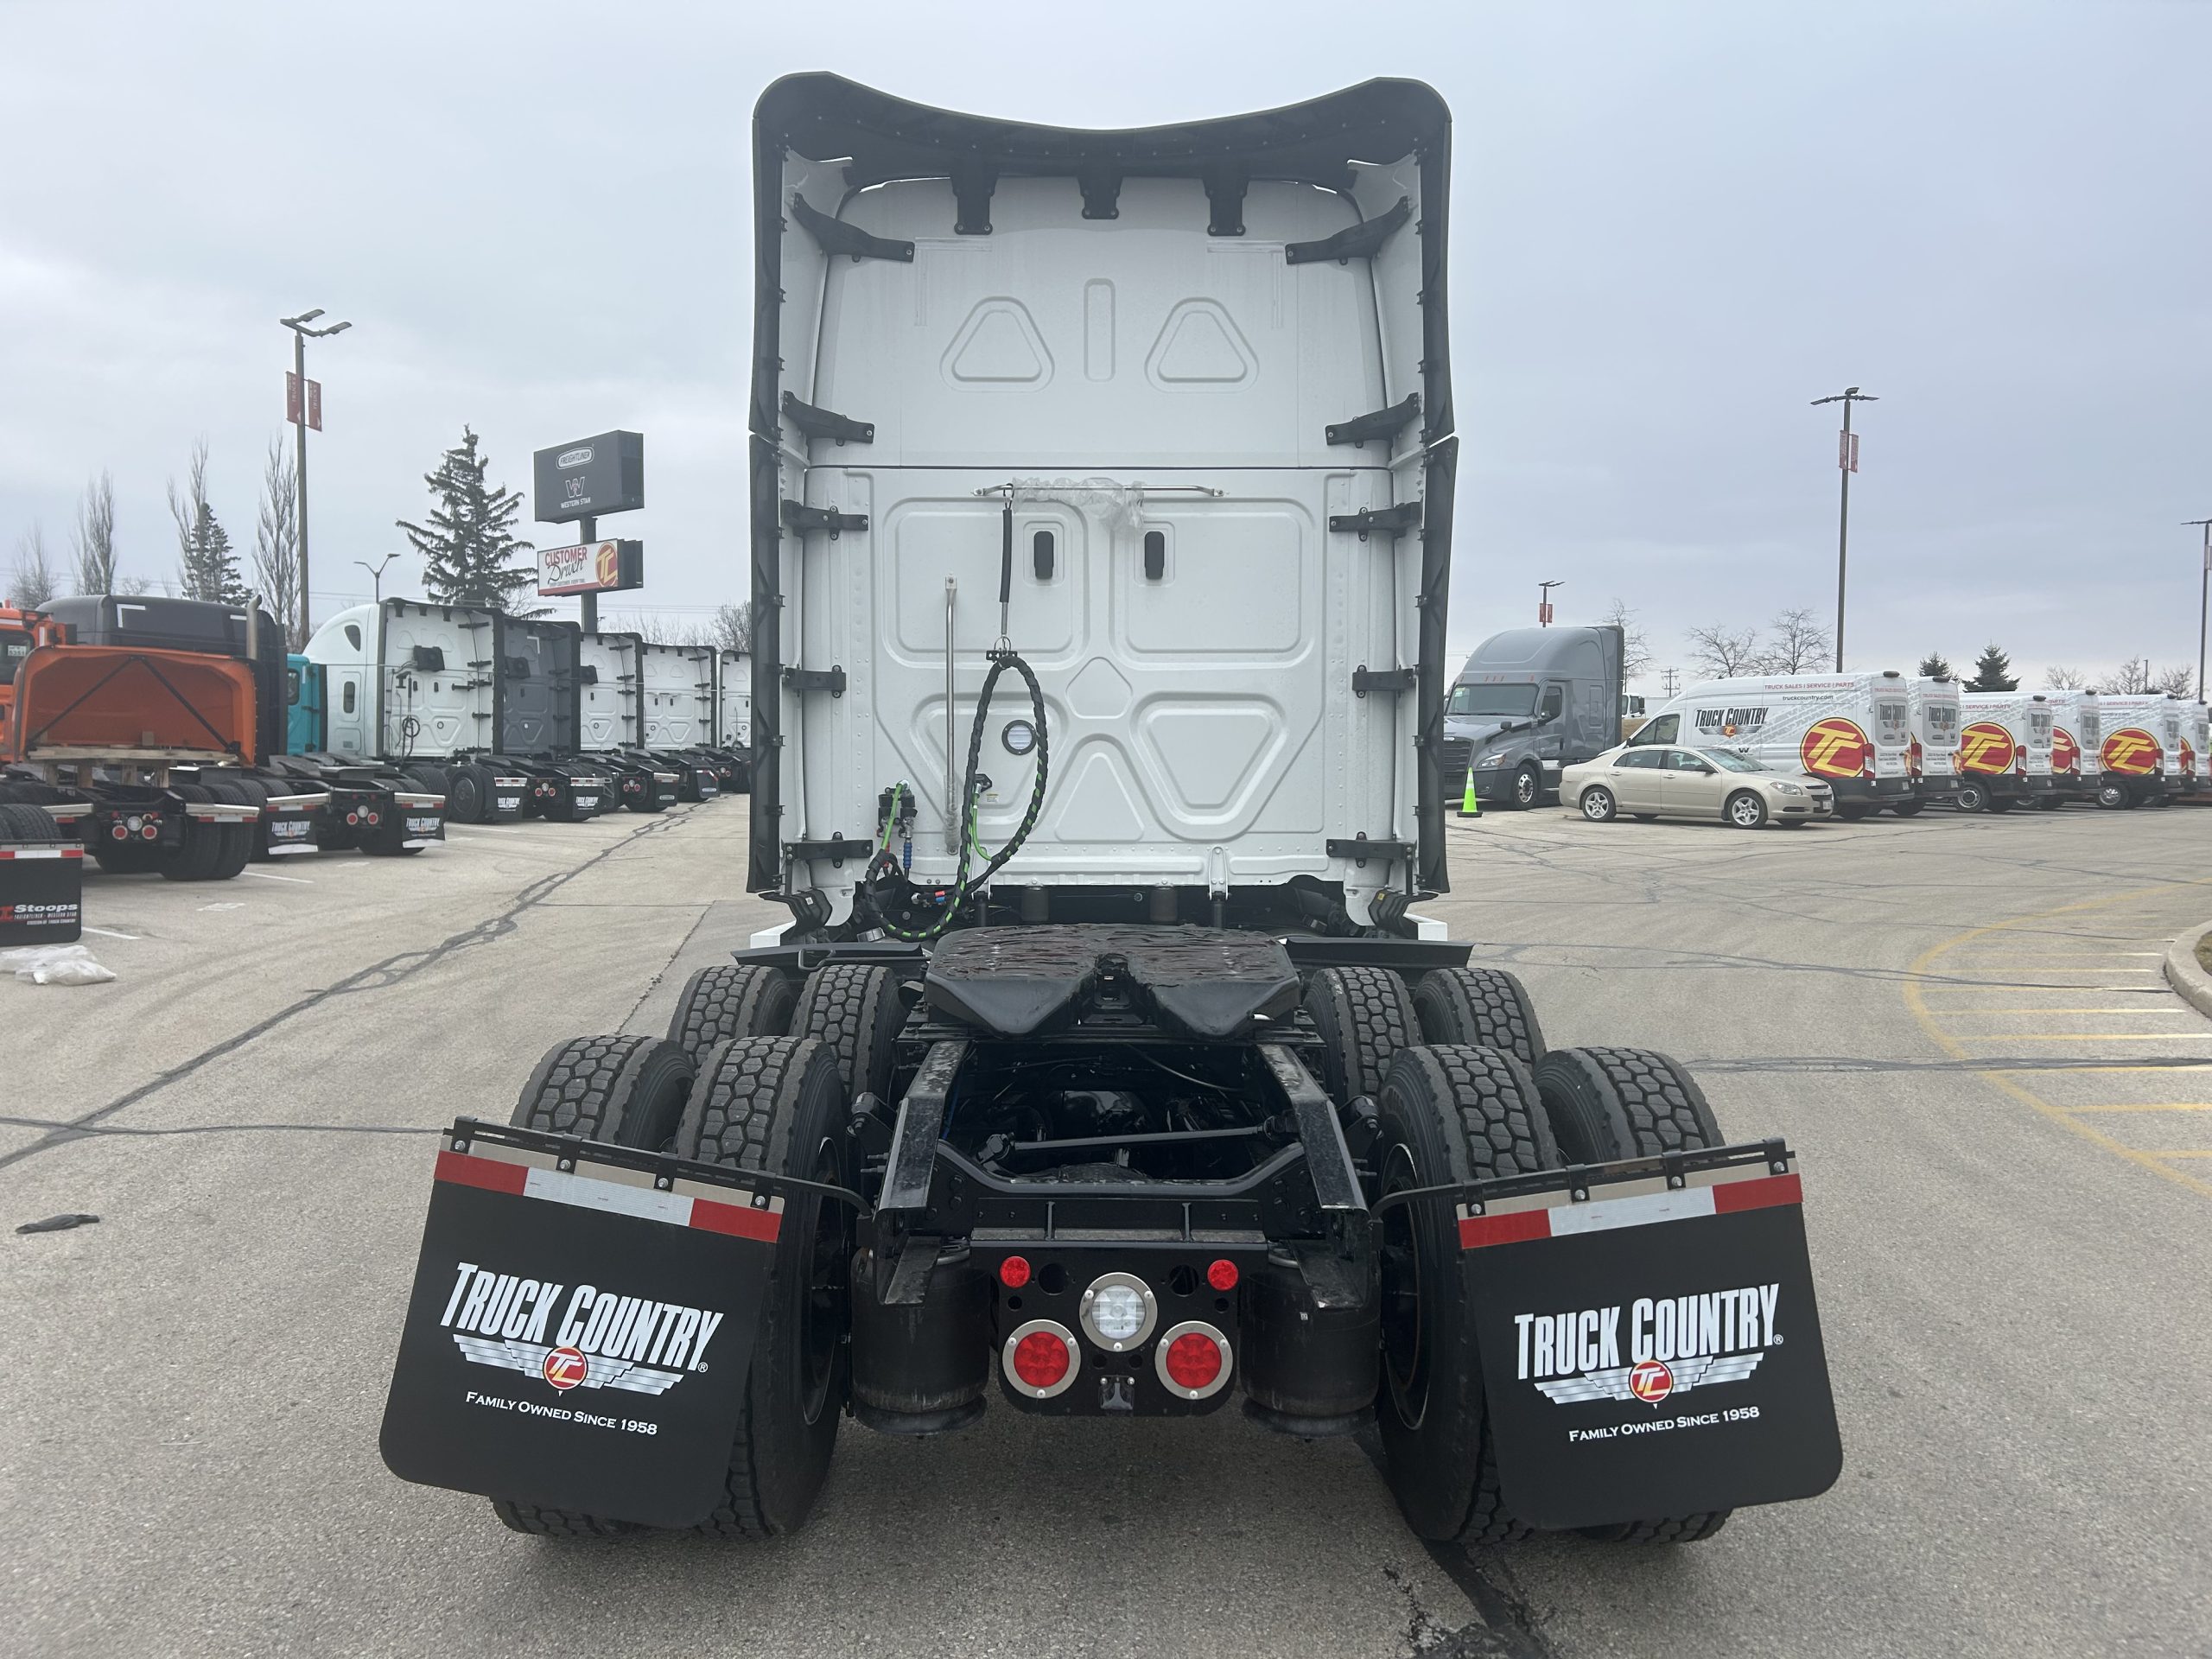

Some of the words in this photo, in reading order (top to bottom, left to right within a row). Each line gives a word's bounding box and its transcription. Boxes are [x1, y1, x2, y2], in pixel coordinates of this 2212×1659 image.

[561, 499, 579, 508] WESTERN
[545, 547, 588, 566] CUSTOMER
[547, 559, 583, 585] Driven
[1694, 709, 1725, 727] TRUCK
[1726, 707, 1769, 726] COUNTRY
[14, 904, 78, 912] Stoops
[440, 1262, 564, 1344] TRUCK
[556, 1284, 724, 1371] COUNTRY
[1515, 1306, 1621, 1380] TRUCK
[1631, 1283, 1780, 1363] COUNTRY
[465, 1391, 517, 1411] FAMILY
[518, 1401, 572, 1421] OWNED
[573, 1410, 616, 1429] SINCE
[620, 1418, 658, 1435] 1958
[1568, 1424, 1618, 1442] FAMILY
[1621, 1417, 1675, 1435] OWNED
[1676, 1412, 1719, 1428] SINCE
[1723, 1406, 1760, 1422] 1958
